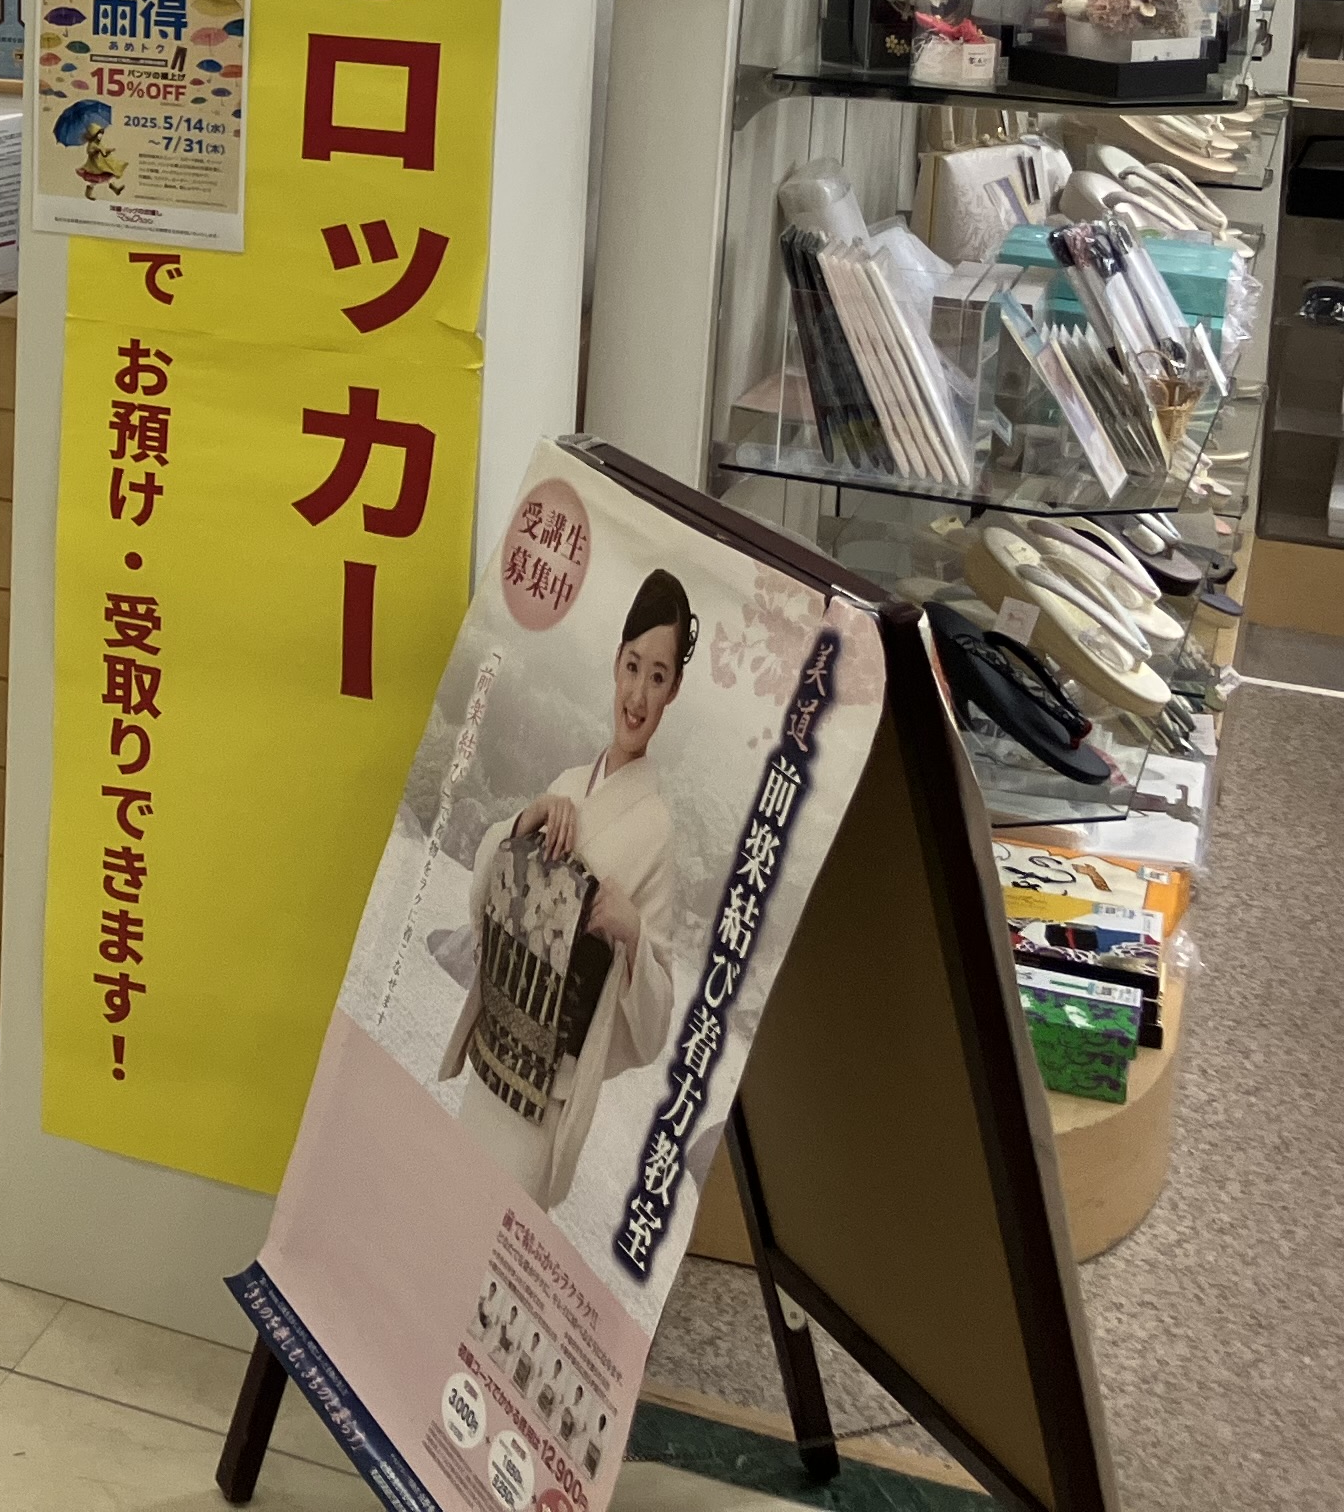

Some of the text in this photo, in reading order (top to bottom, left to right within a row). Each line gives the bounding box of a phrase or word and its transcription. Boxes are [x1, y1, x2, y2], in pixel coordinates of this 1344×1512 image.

[90, 67, 188, 103] 15%OFF
[521, 500, 589, 568] 受講生
[505, 544, 575, 612] 募集中
